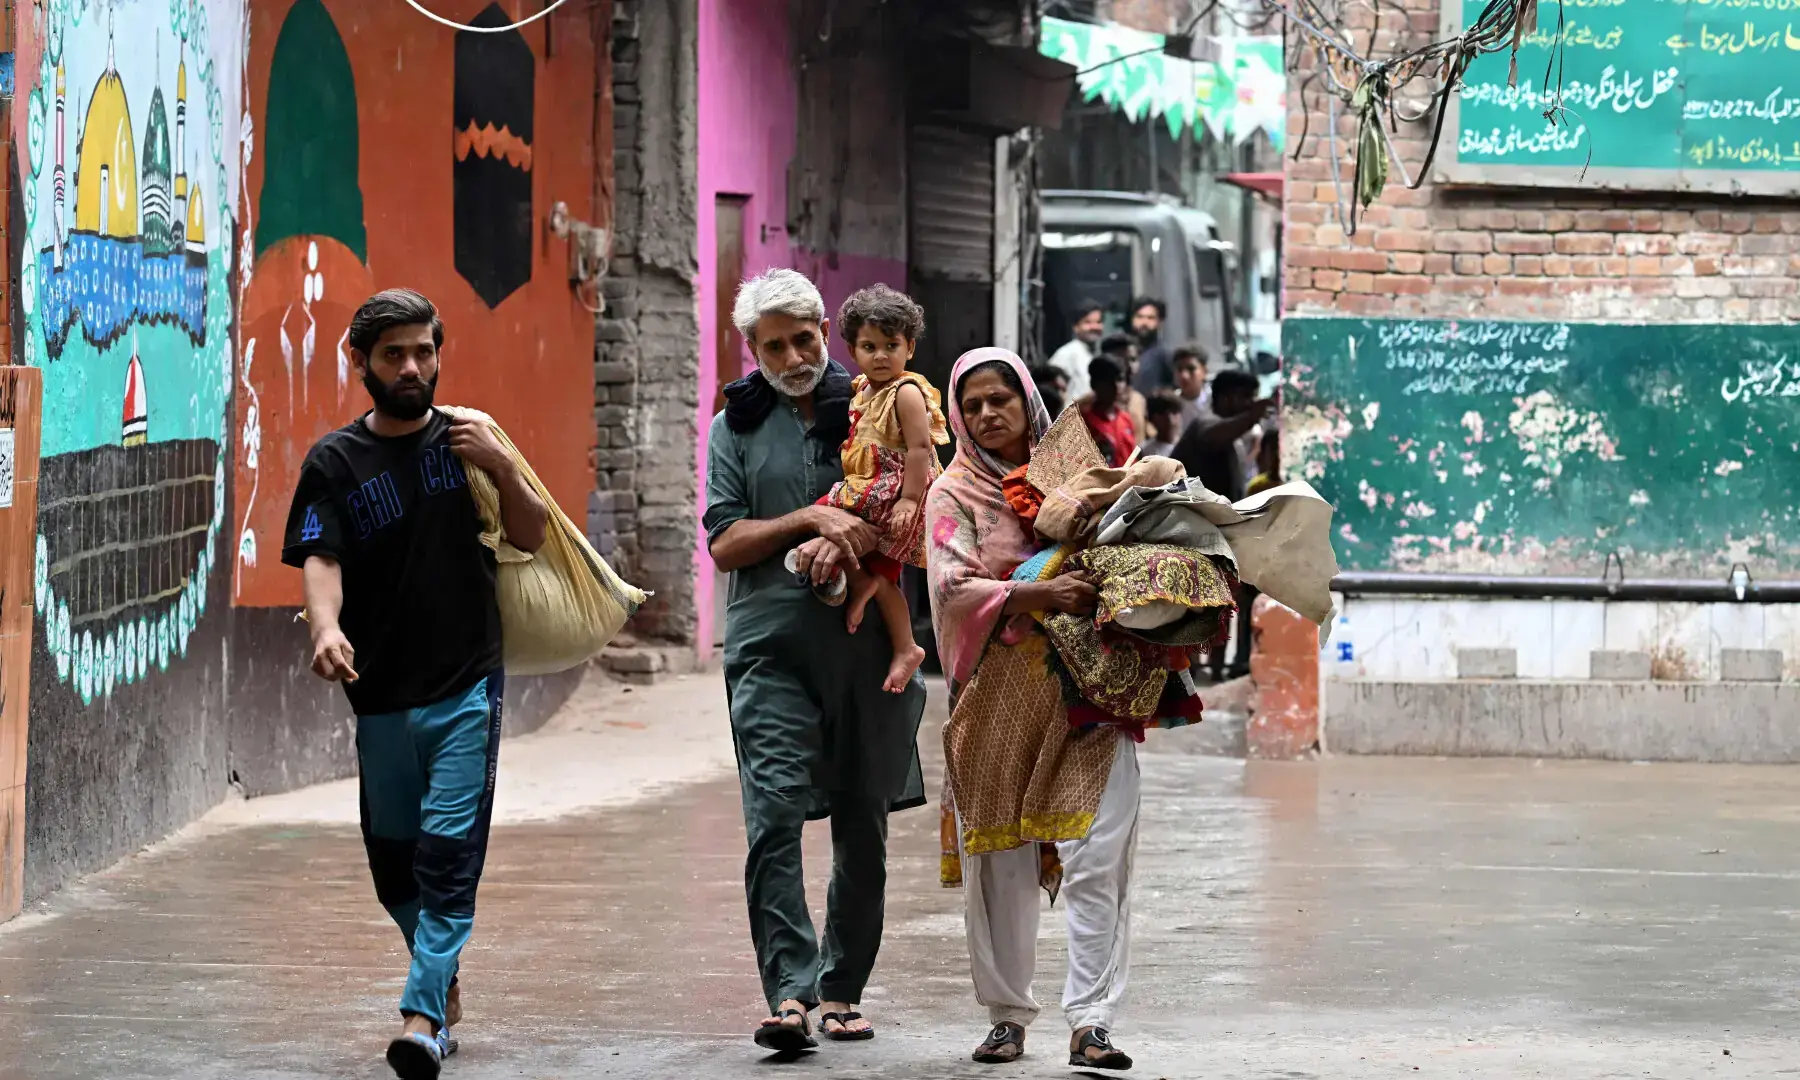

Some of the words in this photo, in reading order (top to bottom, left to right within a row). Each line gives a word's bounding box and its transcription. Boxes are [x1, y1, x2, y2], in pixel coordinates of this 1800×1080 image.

[301, 505, 323, 541] LA
[346, 470, 405, 540] CHI
[419, 444, 466, 496] CA
